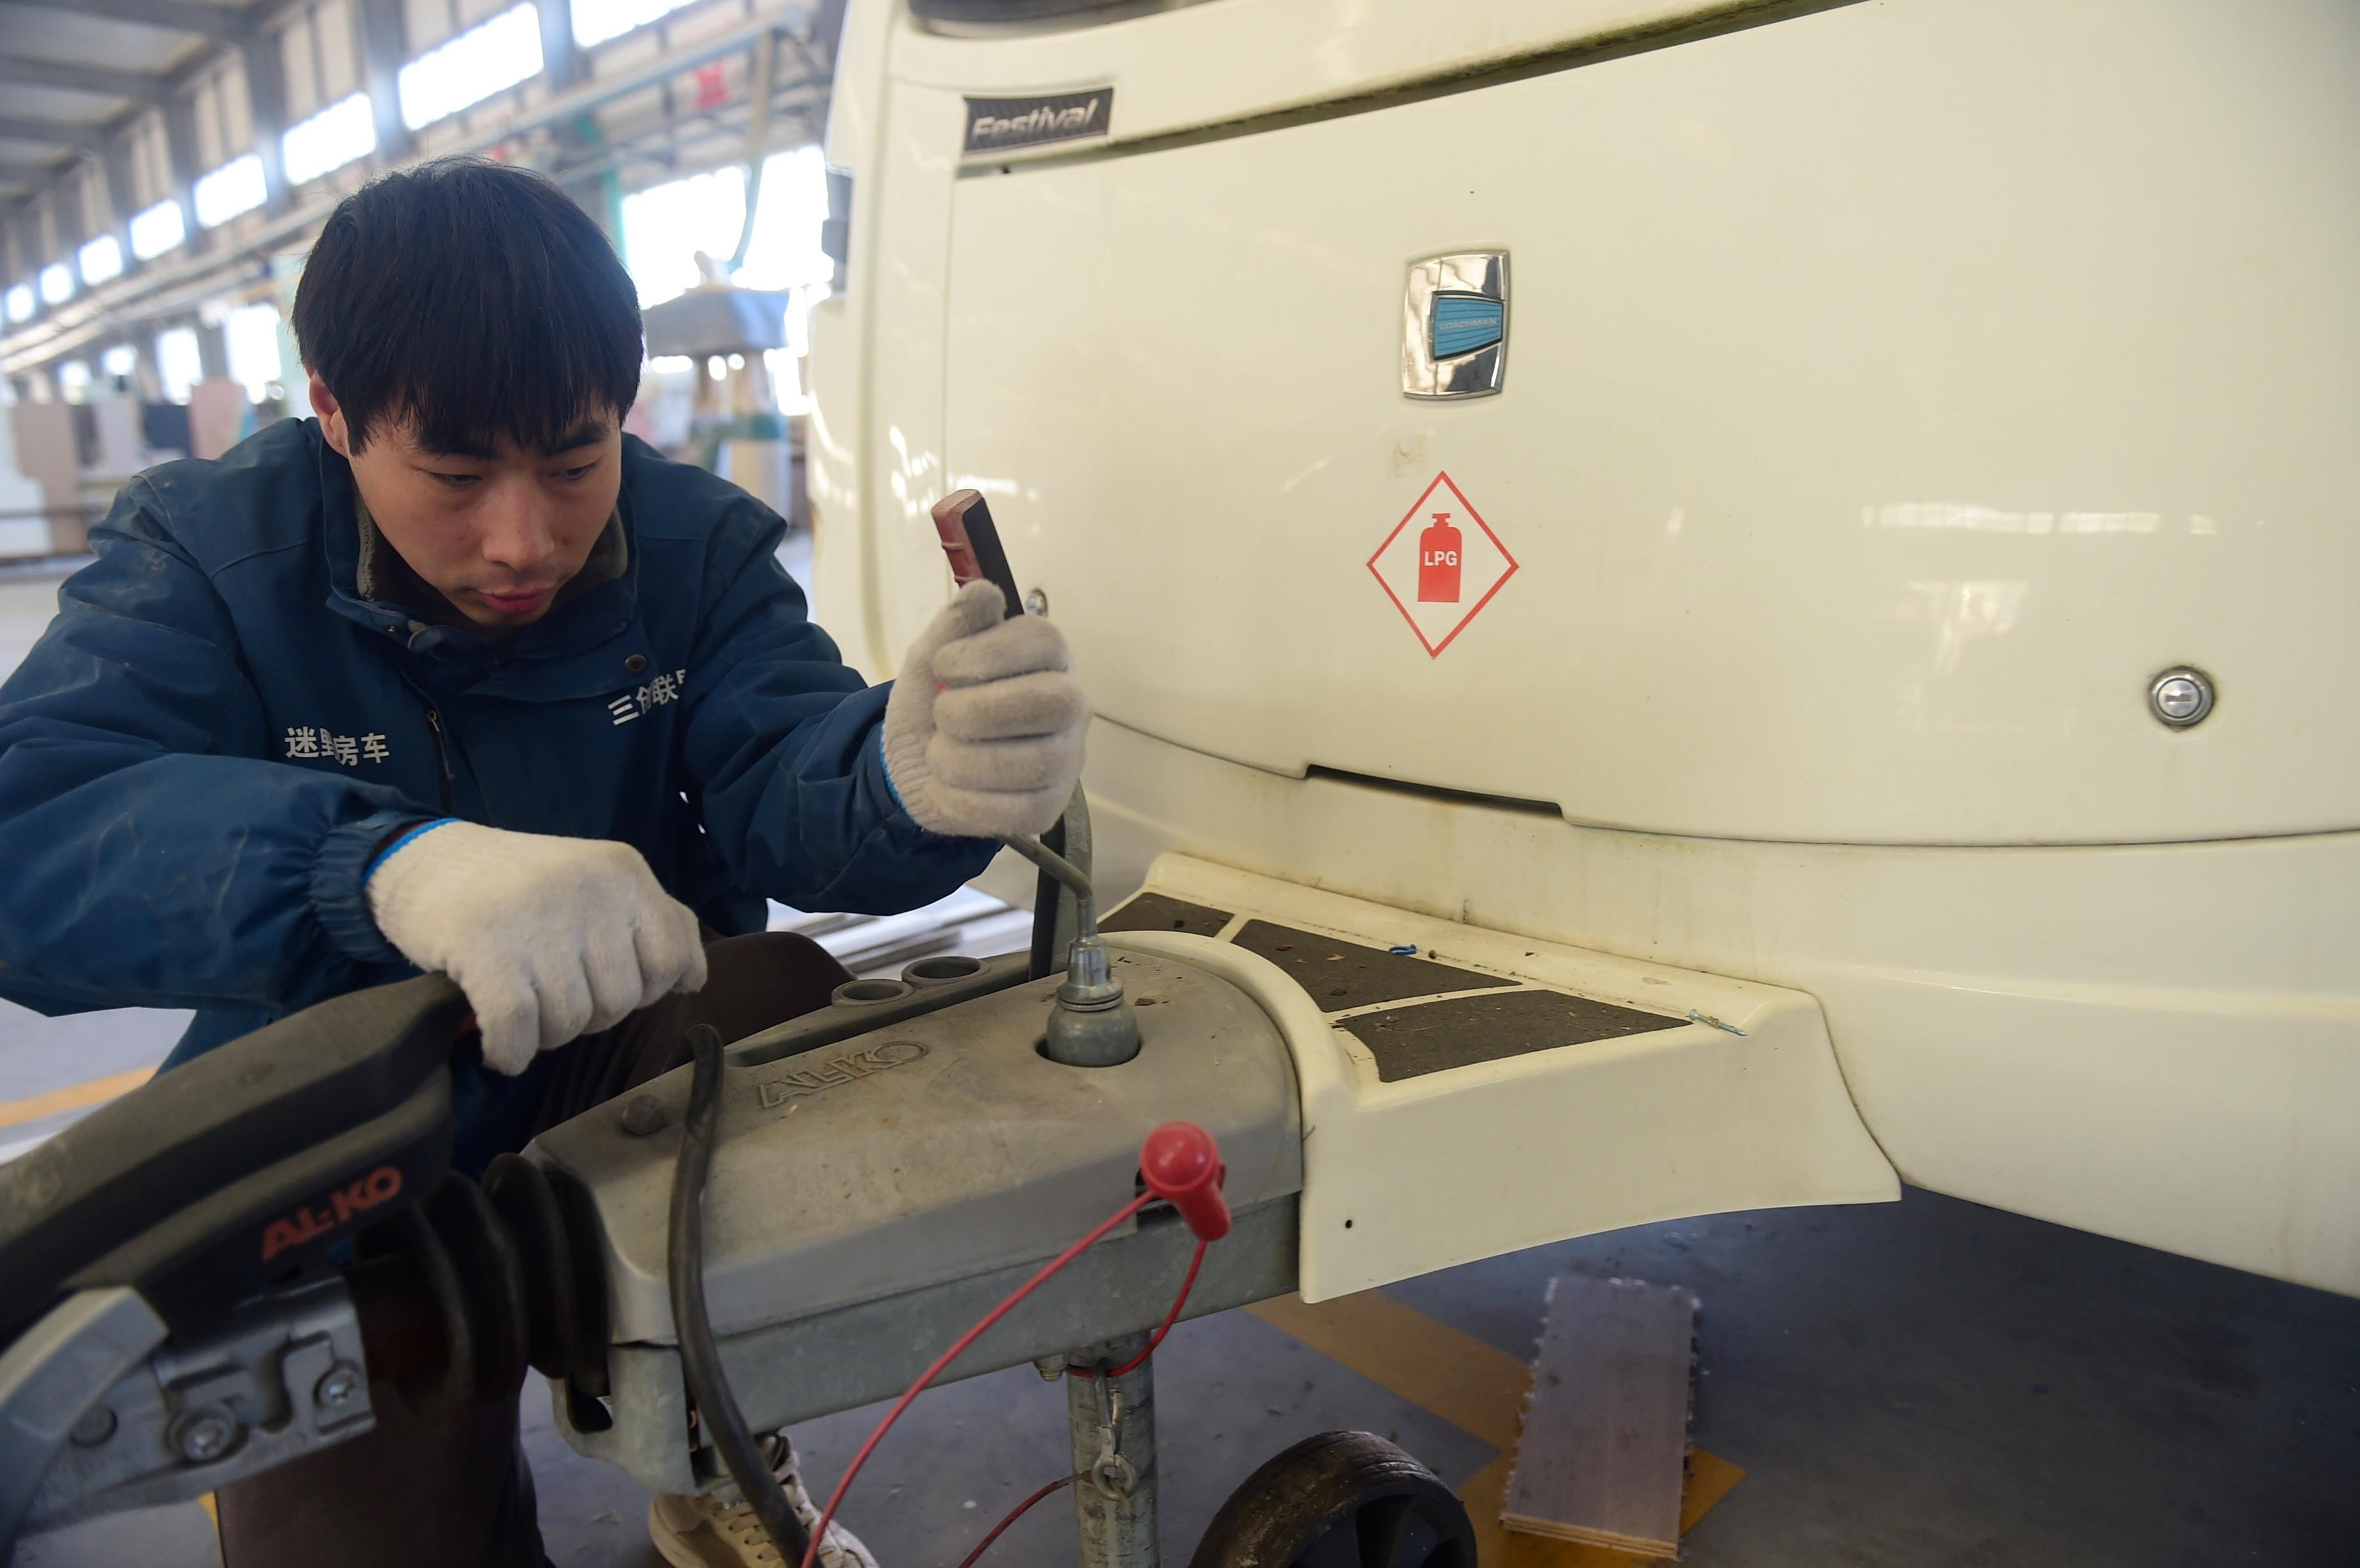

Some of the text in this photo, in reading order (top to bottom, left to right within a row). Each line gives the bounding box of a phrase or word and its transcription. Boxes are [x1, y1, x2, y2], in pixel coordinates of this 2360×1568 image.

[972, 98, 1099, 138] Festival
[1439, 318, 1497, 329] COACHMAN
[1425, 550, 1458, 566] LPG
[756, 1041, 930, 1108] AL-KO
[261, 1166, 402, 1262] AL-KO
